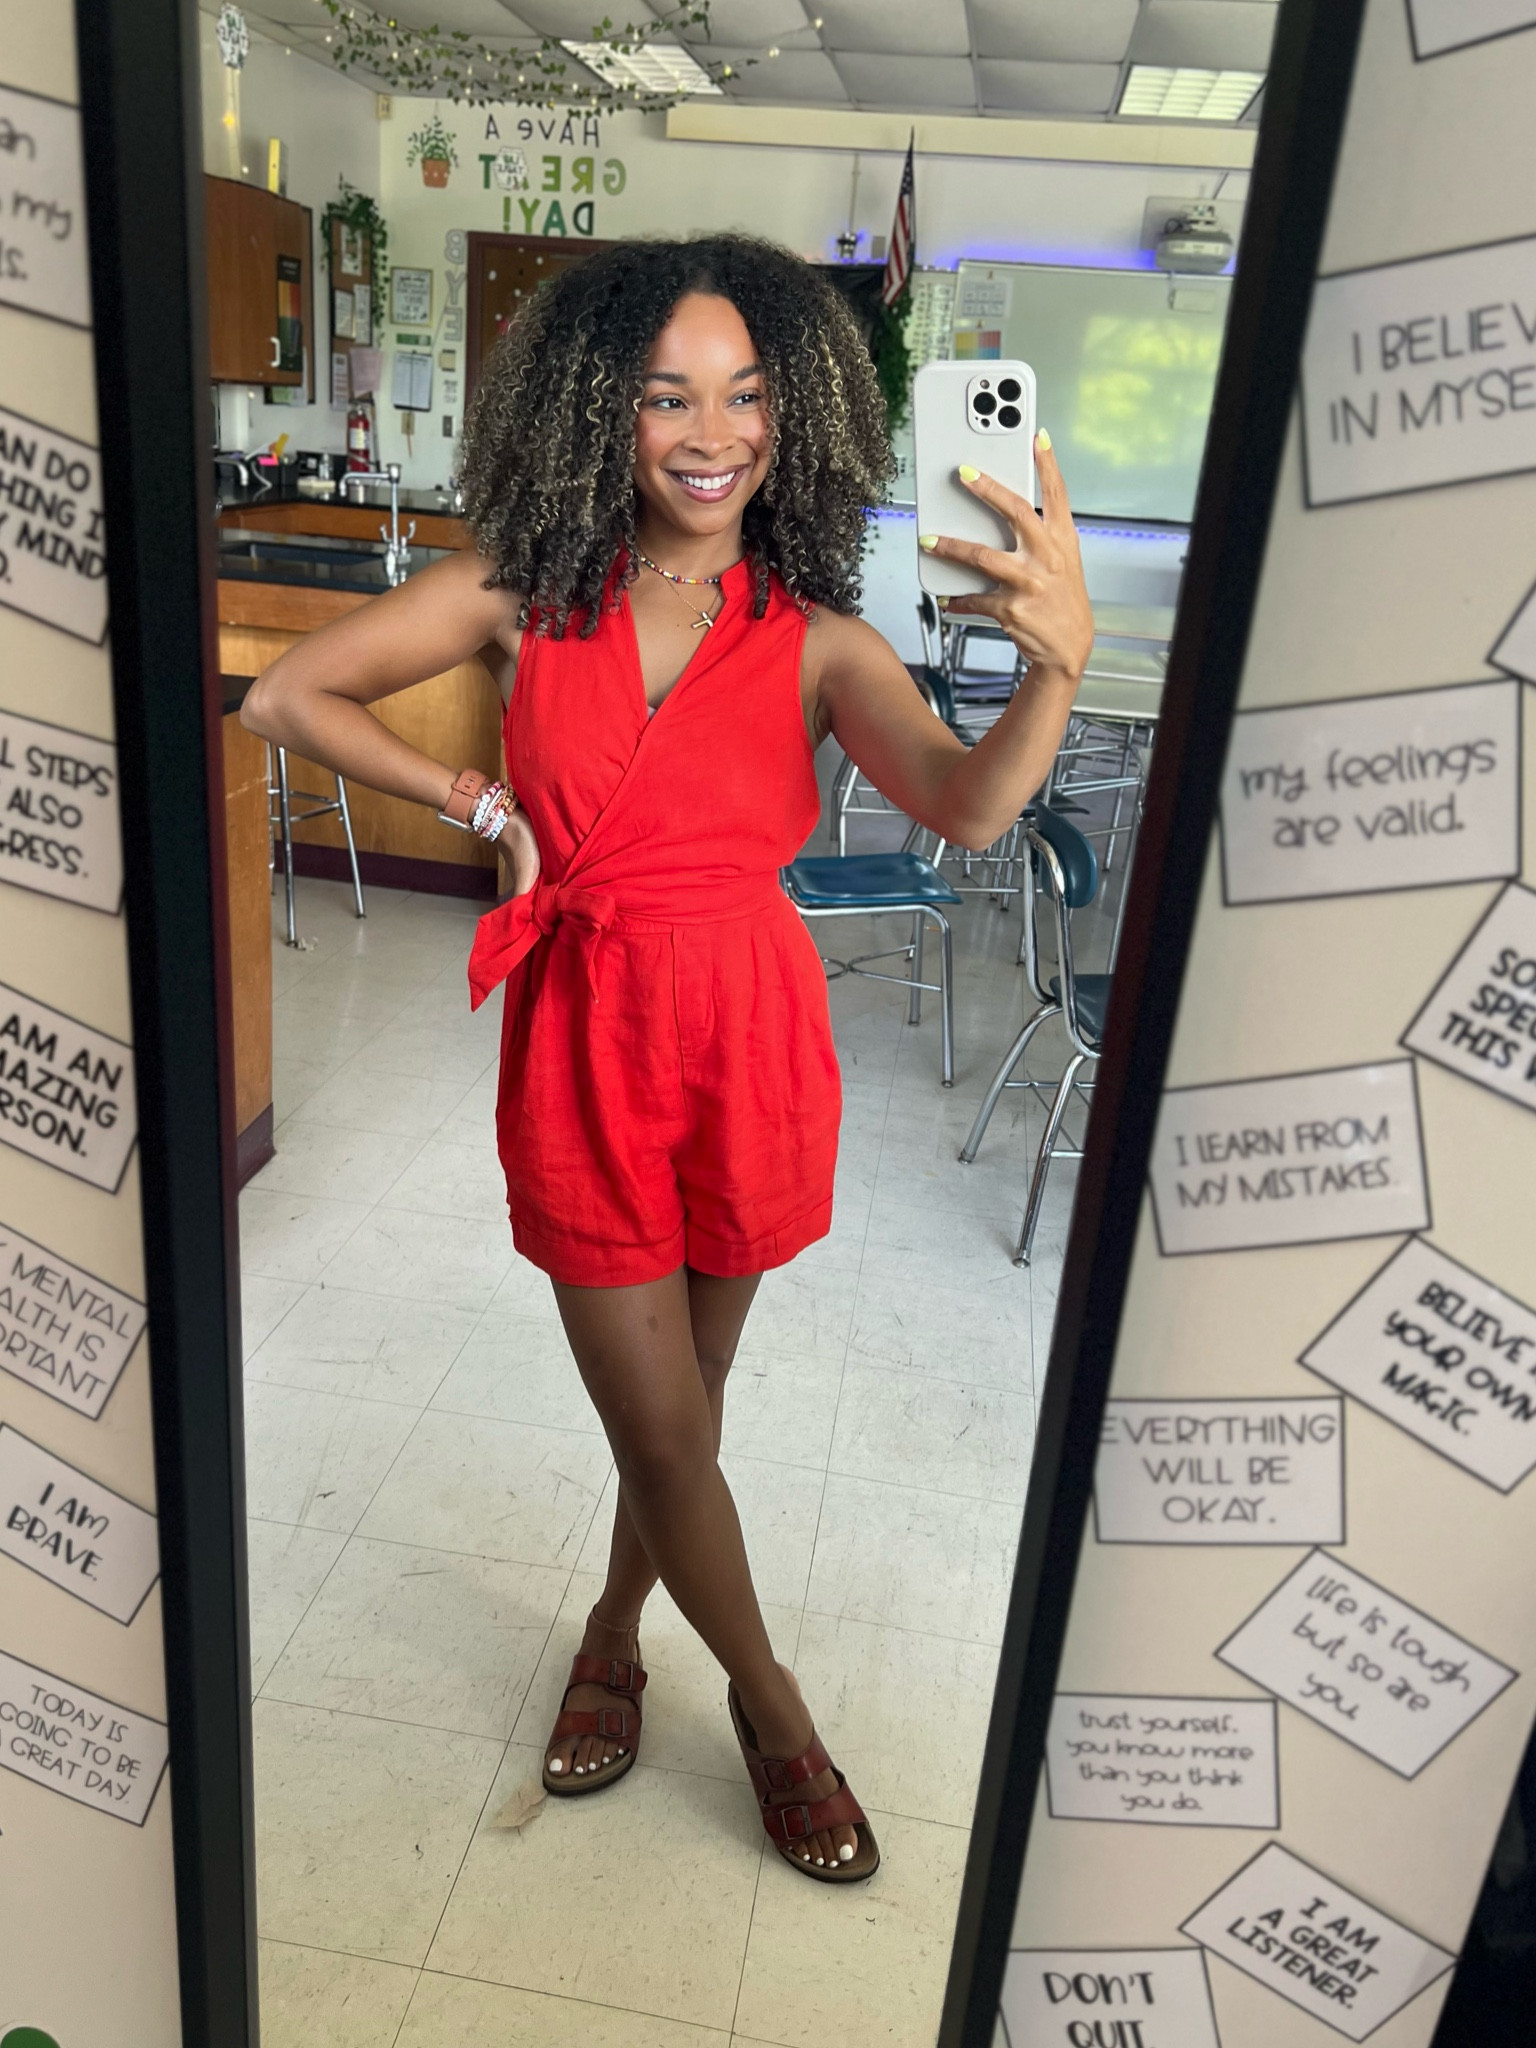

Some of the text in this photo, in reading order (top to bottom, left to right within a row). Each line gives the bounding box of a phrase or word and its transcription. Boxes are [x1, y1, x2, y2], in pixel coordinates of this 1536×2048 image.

[13, 191, 71, 240] my
[1353, 331, 1361, 374] I
[1330, 364, 1536, 444] IN MYSE
[44, 449, 91, 493] DO
[16, 520, 106, 580] MIND
[26, 745, 115, 797] STEPS
[1240, 738, 1498, 802] my feelings
[7, 786, 82, 829] ALSO
[1273, 792, 1465, 847] are valid.
[0, 1013, 123, 1092] AM AN
[1440, 1011, 1521, 1069] THIS
[1175, 1115, 1389, 1166] I LEARN FROM
[1176, 1172, 1228, 1208] MY
[11, 1252, 130, 1340] MENTAL
[1416, 1280, 1536, 1364] BELIEVE
[75, 1330, 105, 1362] IS
[1381, 1362, 1479, 1437] MAGIC.
[1465, 1366, 1536, 1423] OWN
[1100, 1413, 1337, 1445] EVERYTHING
[39, 1482, 54, 1506] I
[1142, 1456, 1291, 1485] WILL BE
[1162, 1495, 1276, 1524] OKAY.
[7, 1504, 103, 1581] BRAVE.
[1305, 1574, 1471, 1694] life is tough
[1293, 1611, 1431, 1713] but so are
[31, 1684, 129, 1743] TODAY IS
[1079, 1710, 1238, 1734] trust yourself.
[1298, 1672, 1360, 1721] you
[0, 1702, 142, 1779] GOING TO BE
[11, 1736, 82, 1780] GREAT
[1066, 1739, 1254, 1760] you know more
[1079, 1762, 1243, 1787] than you think
[1121, 1794, 1164, 1811] you
[1257, 1907, 1380, 1984] A GREAT
[1299, 1896, 1381, 1955] I AM
[1226, 1916, 1358, 2010] LISTENER.
